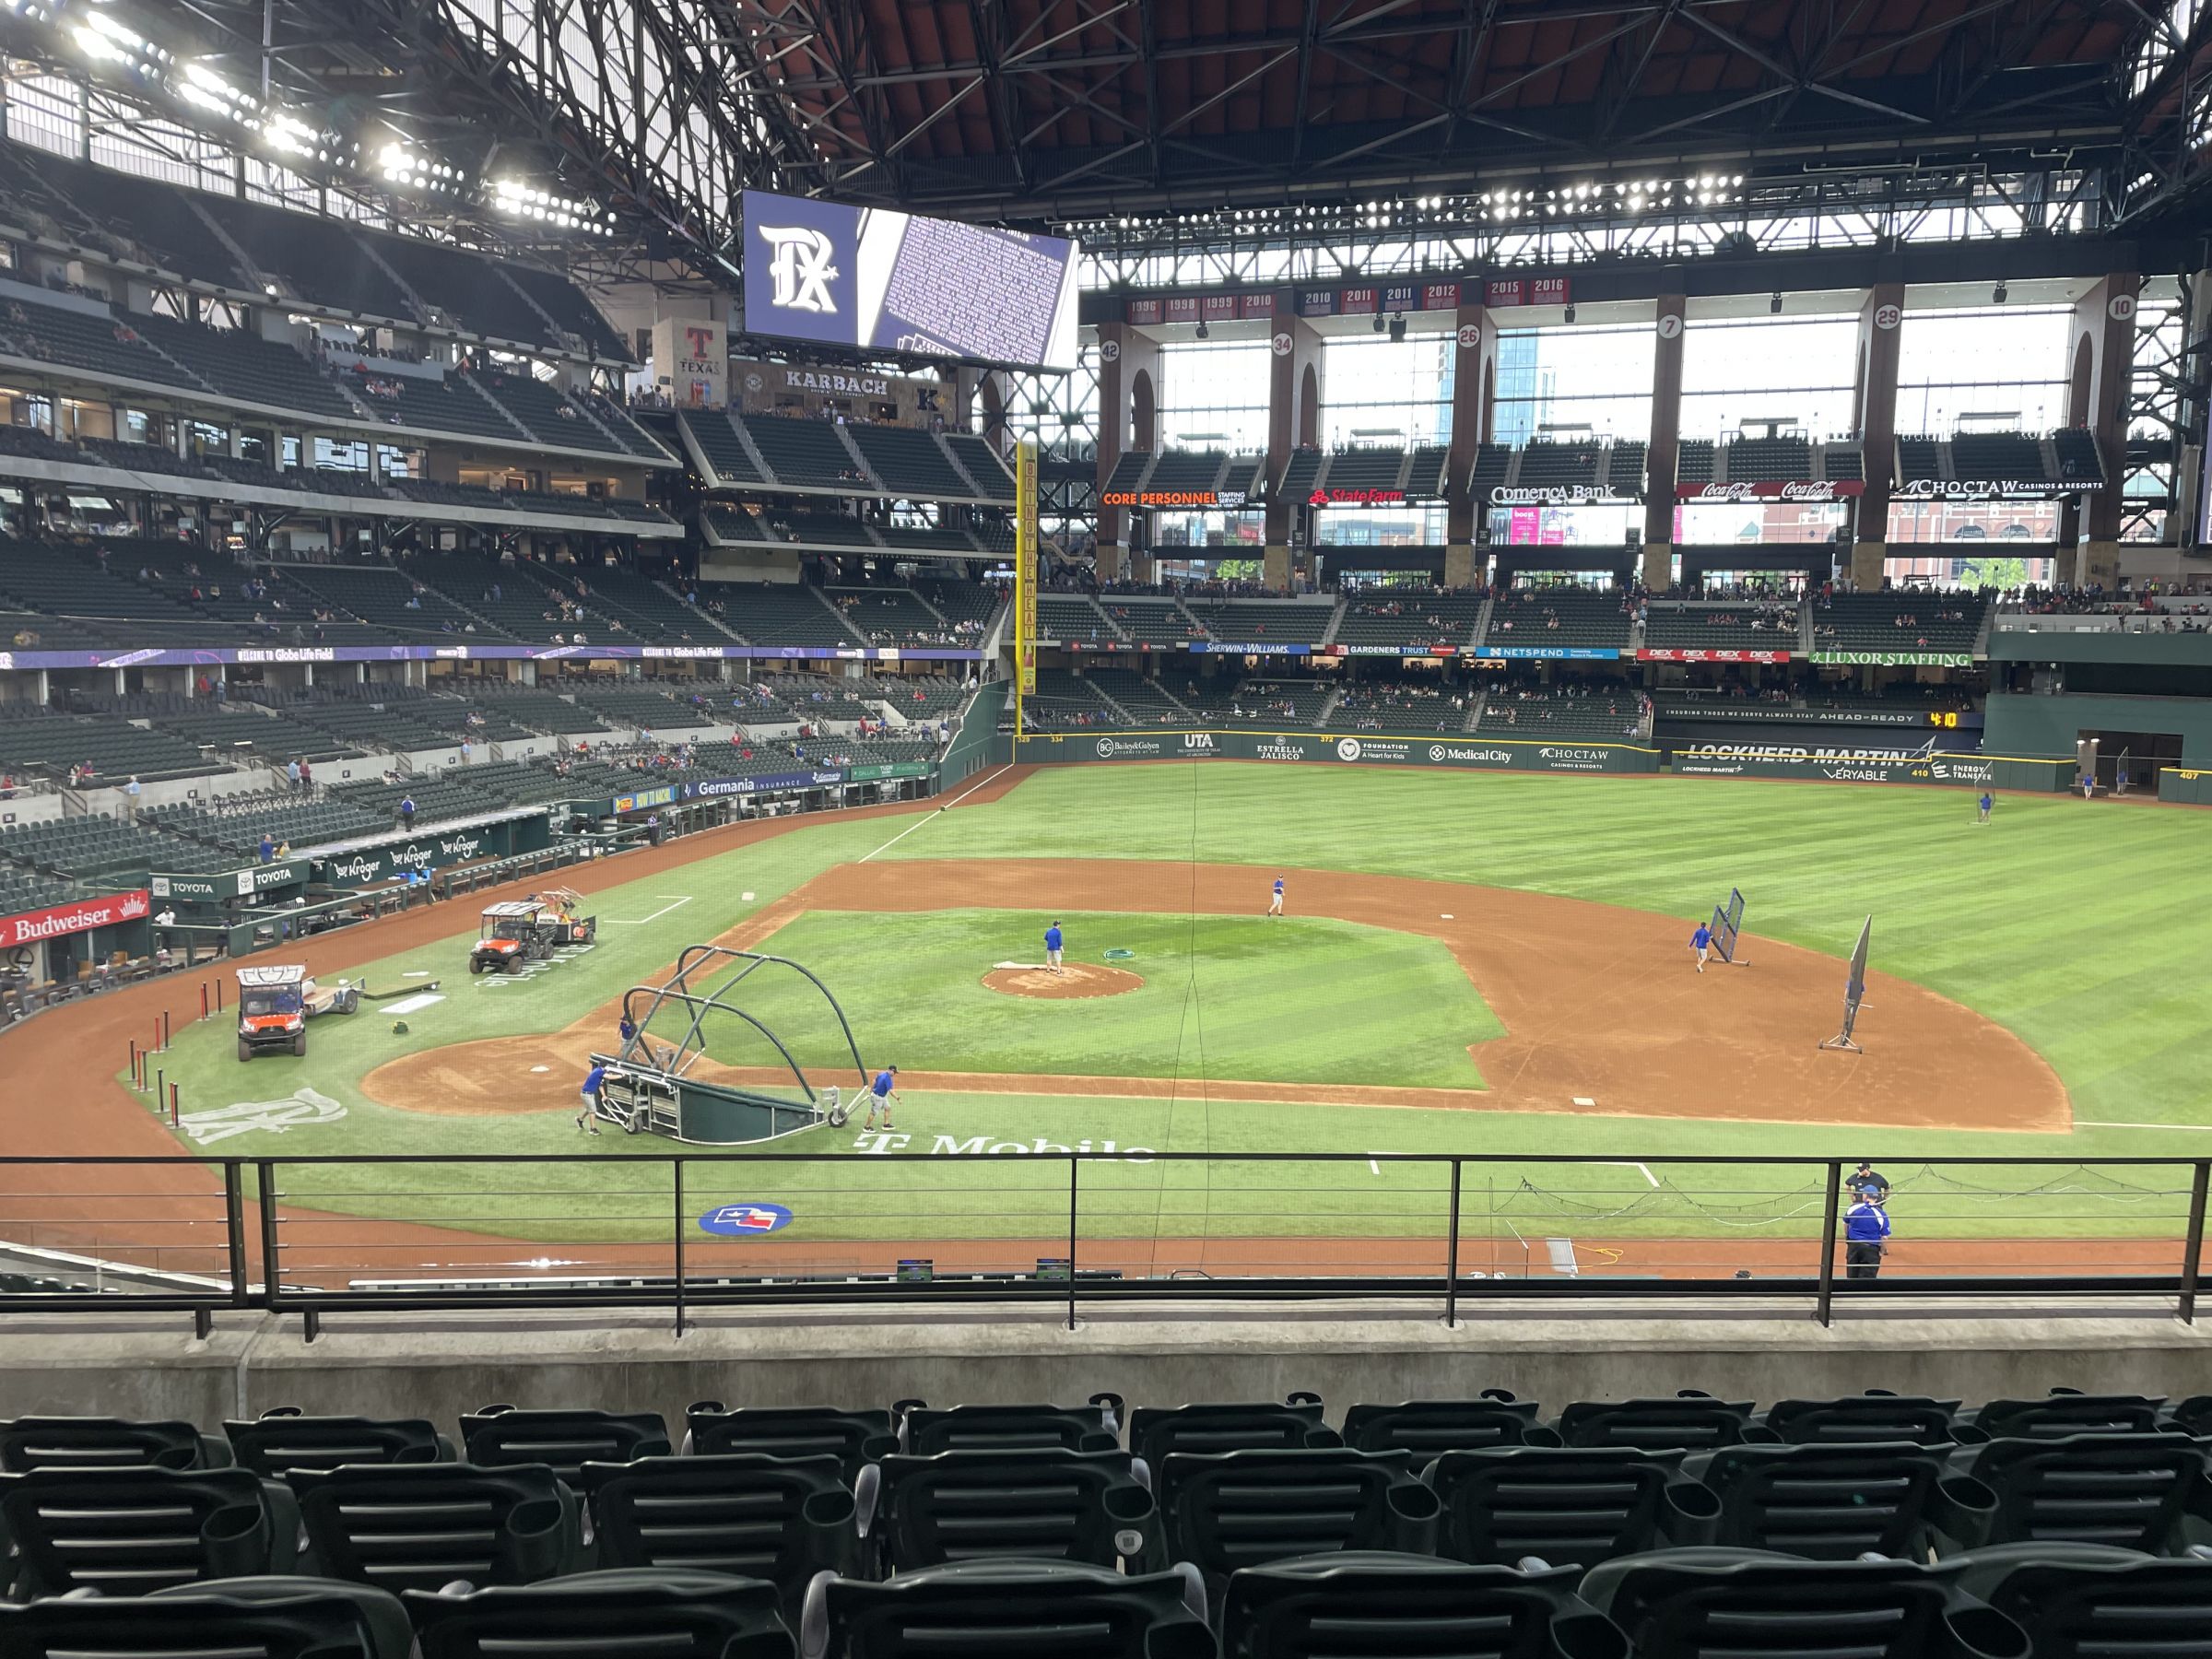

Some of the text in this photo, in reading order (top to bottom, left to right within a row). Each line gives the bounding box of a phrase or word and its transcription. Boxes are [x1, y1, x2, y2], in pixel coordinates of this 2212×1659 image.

[1491, 281, 1519, 293] 2015
[1535, 278, 1563, 291] 2016
[1305, 292, 1330, 304] 2010
[1347, 289, 1371, 301] 2011
[1387, 288, 1412, 300] 2011
[1429, 285, 1454, 298] 2012
[1132, 301, 1157, 312] 1996
[1170, 299, 1195, 311] 1998
[1206, 297, 1232, 309] 1999
[1246, 294, 1271, 306] 2010
[2114, 301, 2130, 314] 10
[1878, 310, 1899, 324] 29
[1665, 320, 1676, 334] 7
[1460, 329, 1477, 343] 26
[1275, 338, 1290, 351] 34
[1100, 345, 1118, 359] 42
[679, 360, 721, 375] TEXAS
[786, 371, 888, 394] KARBACH
[1572, 484, 1616, 499] Bank
[1917, 479, 2018, 494] CHOCTAW
[2065, 481, 2103, 489] RESORTS
[1103, 491, 1218, 505] CORE PERSONNEL
[1025, 583, 1033, 640] HEAT
[275, 648, 299, 661] Globe
[300, 648, 314, 660] Life
[314, 648, 334, 660] Field
[673, 647, 694, 656] Globe
[694, 647, 706, 656] Life
[707, 647, 723, 656] Field
[1350, 646, 1400, 654] GARDENERS
[1504, 648, 1563, 656] NETSPEND
[1826, 653, 1969, 665] LUXOR STAFFING
[1930, 712, 1958, 727] 4:10
[1184, 734, 1213, 748] UTA
[1257, 745, 1304, 754] ESTRELLA
[1448, 748, 1512, 763] Medical City
[1546, 747, 1608, 759] CHOCTAW
[1813, 748, 1907, 767] MARTIN
[1953, 765, 1983, 773] ENERGY
[1953, 771, 1992, 781] TRANSFER
[2180, 772, 2199, 781] 407
[699, 778, 755, 794] Germania
[756, 780, 800, 790] INSURANCE
[453, 835, 478, 858] Kroger
[404, 845, 432, 868] Kroger
[349, 856, 380, 881] Kroger
[255, 868, 291, 885] TOYOTA
[172, 883, 213, 893] TOYOTA
[15, 909, 111, 941] Budweiser
